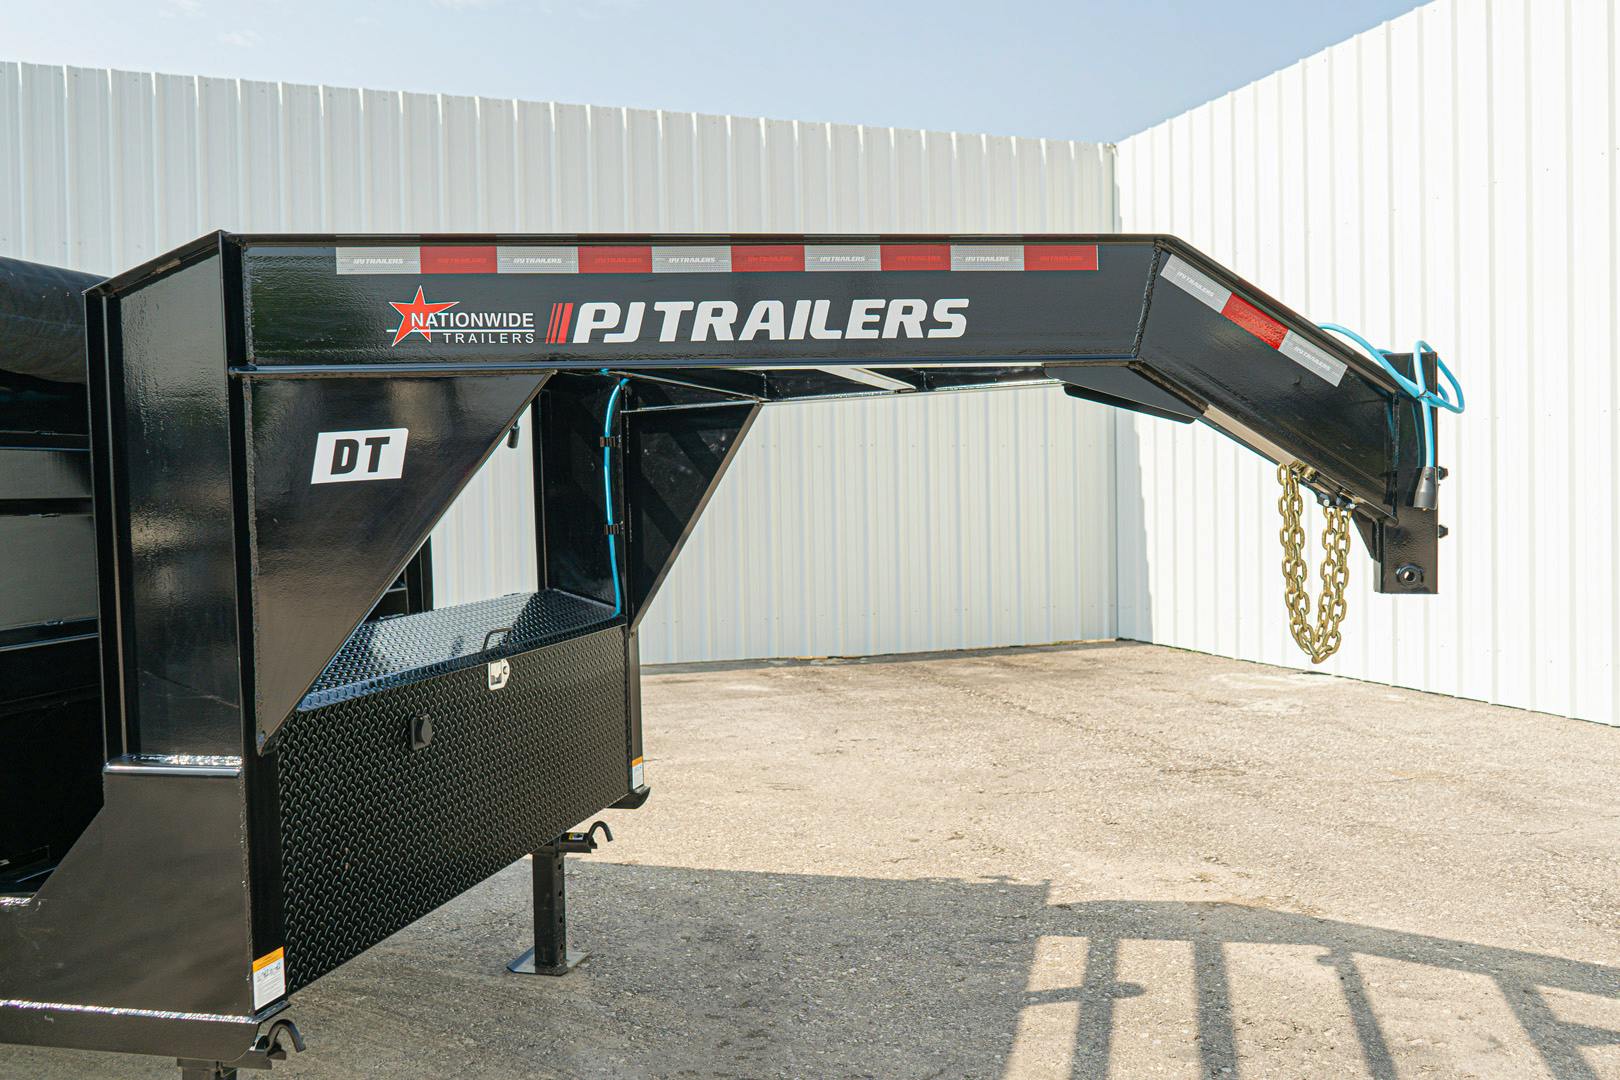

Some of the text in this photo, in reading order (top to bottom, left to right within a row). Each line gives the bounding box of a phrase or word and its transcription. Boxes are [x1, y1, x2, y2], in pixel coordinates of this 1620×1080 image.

[410, 312, 534, 327] NATIONWIDE
[653, 298, 970, 342] TRAILERS
[443, 332, 534, 344] TRAILERS
[330, 436, 391, 475] DT
